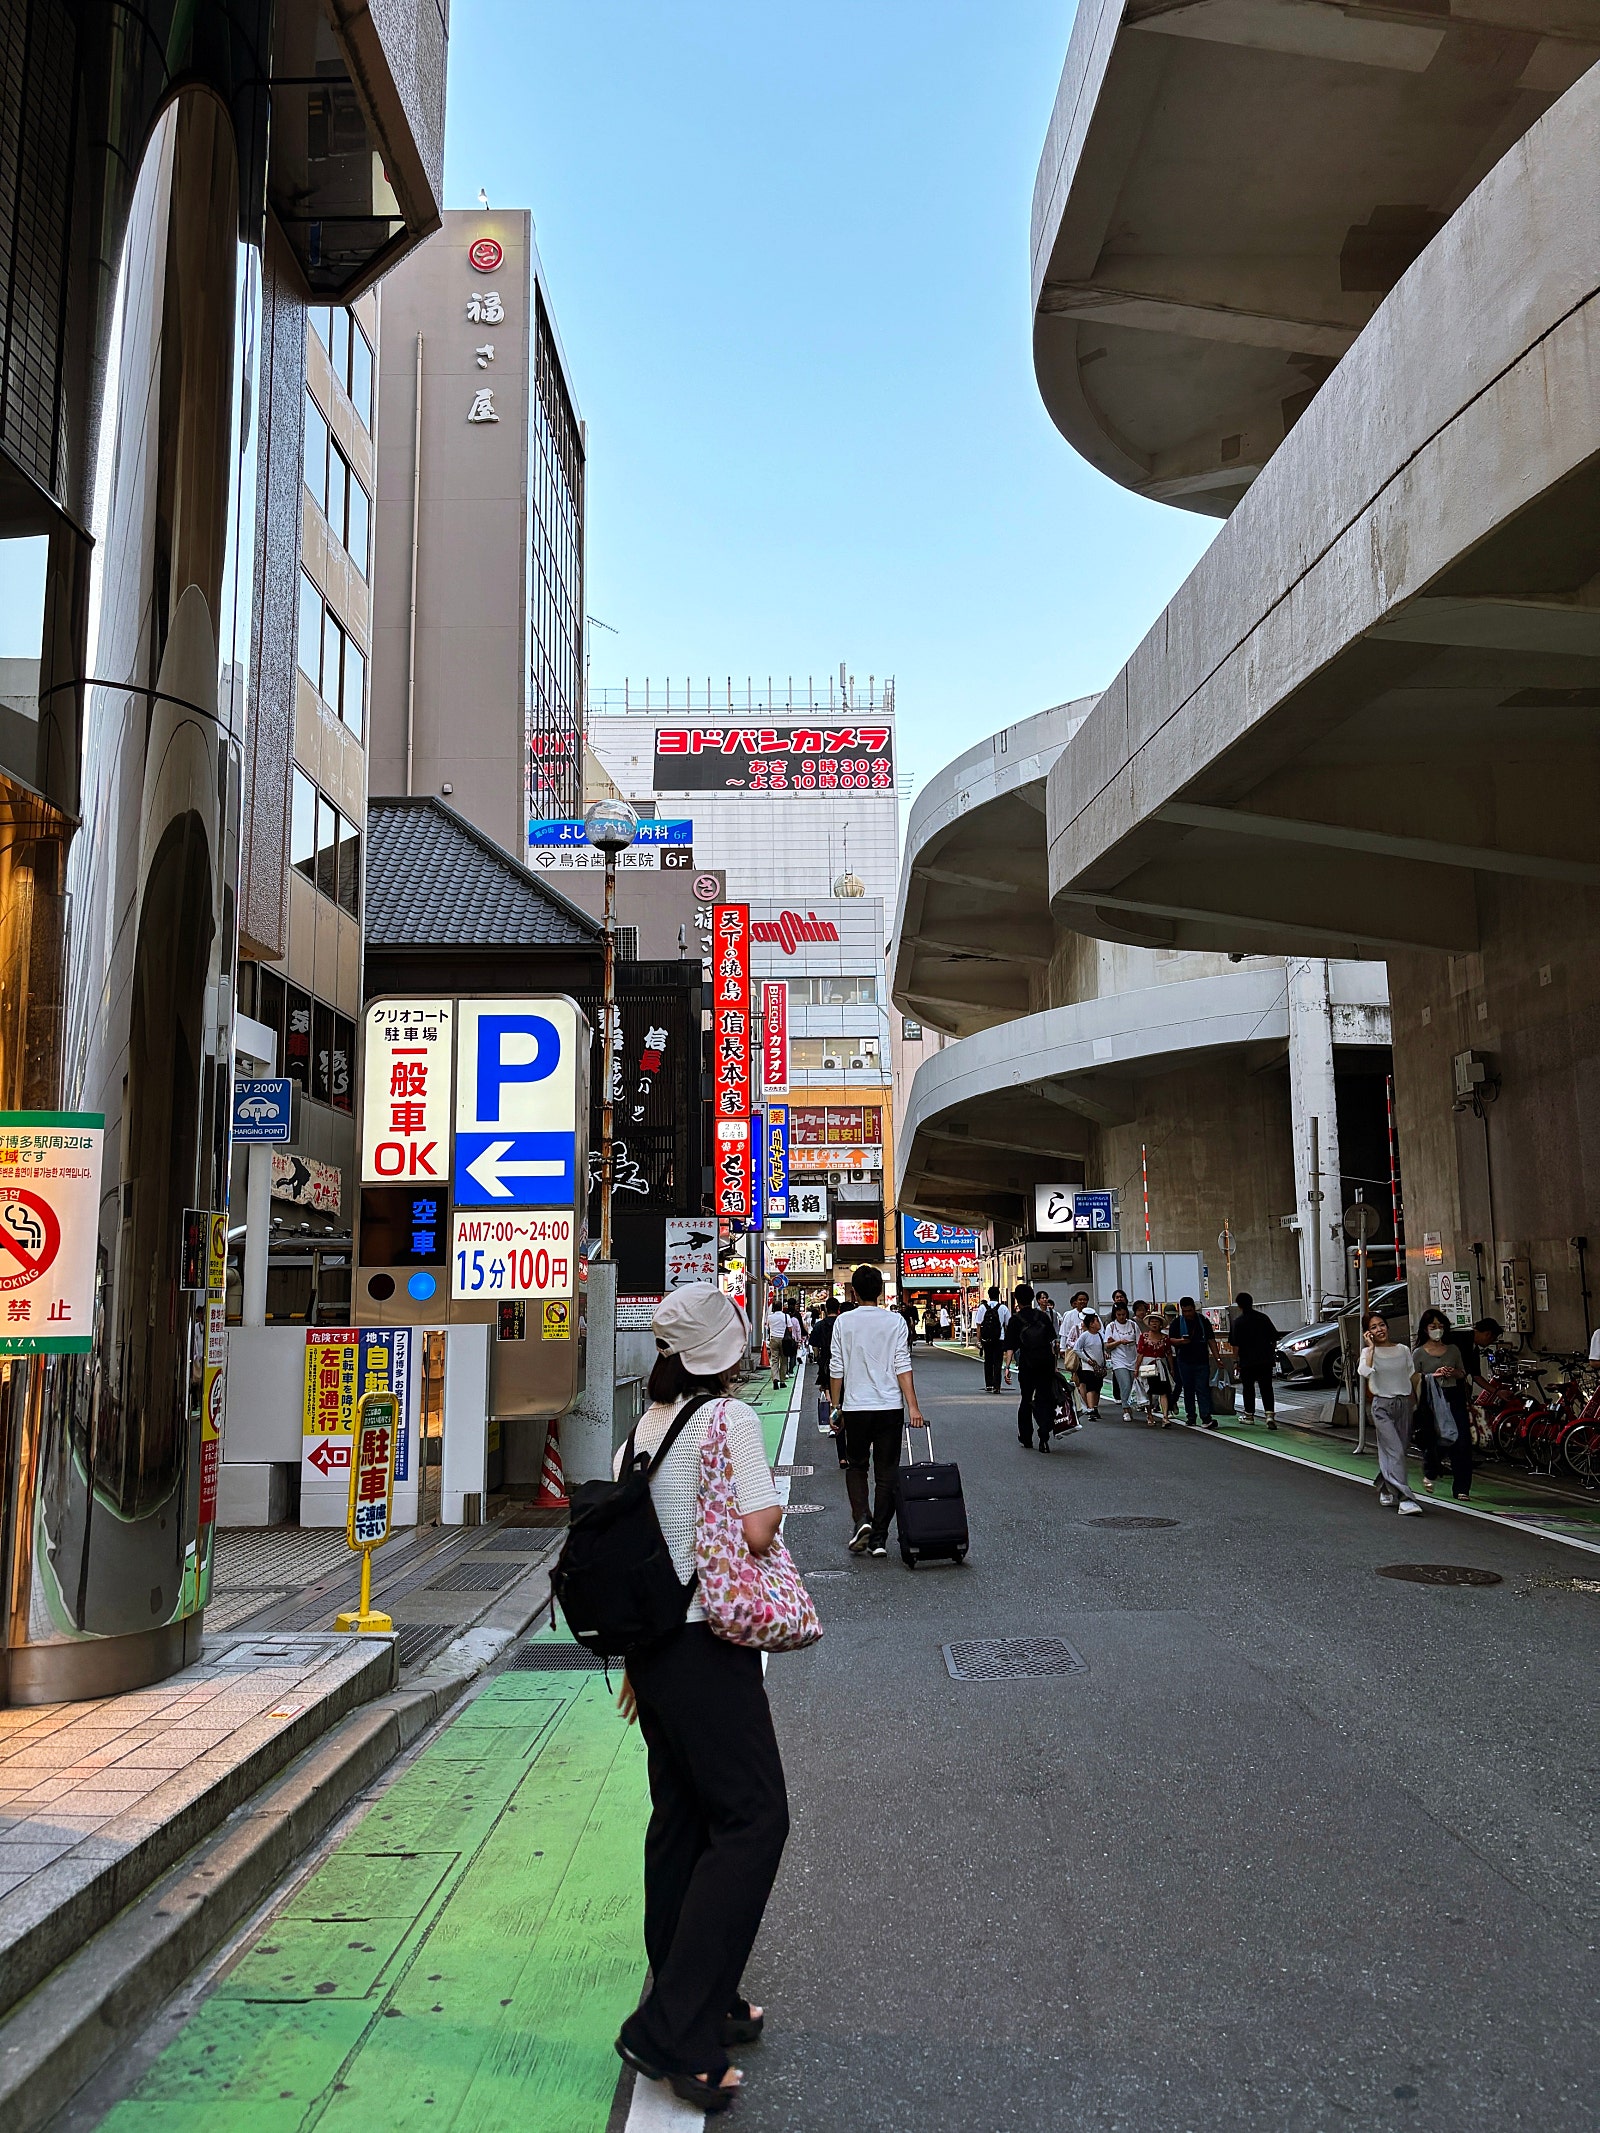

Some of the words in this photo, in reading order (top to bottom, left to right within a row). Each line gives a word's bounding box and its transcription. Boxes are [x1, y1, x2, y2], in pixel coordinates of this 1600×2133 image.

[467, 291, 504, 423] 福さ屋
[657, 728, 889, 754] ヨドバシカメラ
[749, 759, 787, 774] あさ
[801, 758, 890, 774] 9時30分
[665, 852, 689, 867] 6F
[768, 985, 779, 1004] BIG
[374, 1009, 449, 1024] クリオコート
[769, 1005, 779, 1034] ECHO
[384, 1027, 438, 1042] 駐車場
[476, 1015, 561, 1122] P
[719, 1011, 746, 1114] 信長本家
[768, 1035, 783, 1083] カラオケ
[235, 1083, 251, 1093] EV
[253, 1083, 283, 1093] 200V
[389, 1048, 429, 1137] 一般車
[0, 1150, 47, 1163] 域です
[374, 1142, 438, 1176] OK
[769, 1129, 786, 1191] マツモトキヨシ
[721, 1154, 746, 1212] もつ鍋
[411, 1199, 437, 1256] 空車
[1075, 1216, 1090, 1229] 空
[1092, 1208, 1106, 1229] P
[457, 1248, 568, 1291] 15分100円
[311, 1332, 355, 1343] 危険です!
[366, 1332, 390, 1343] 地下
[317, 1348, 341, 1432] 左側通行
[341, 1347, 354, 1431] 自転車を降りて
[317, 1450, 347, 1465] 入口
[360, 1428, 389, 1504] 駐車
[356, 1504, 387, 1523] ご遠慮
[356, 1523, 386, 1540] 下さい
